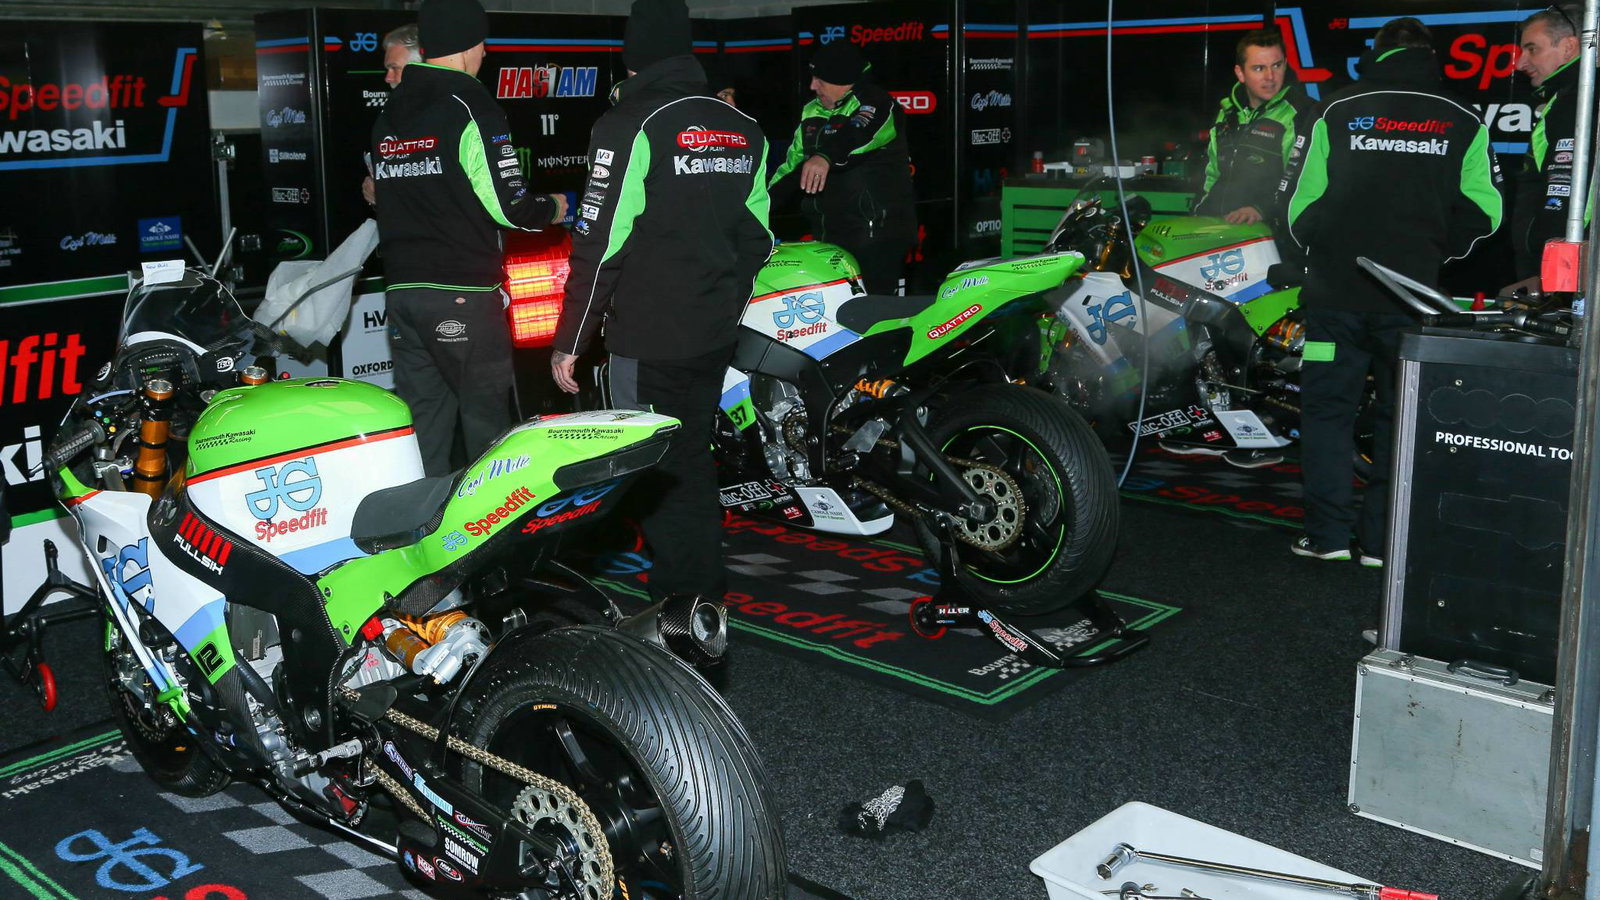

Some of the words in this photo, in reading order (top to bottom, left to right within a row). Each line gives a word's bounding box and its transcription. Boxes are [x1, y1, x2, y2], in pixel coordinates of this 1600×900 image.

[850, 20, 924, 48] Speedfit
[363, 90, 387, 98] Bourn
[1375, 117, 1448, 135] Speedfit
[379, 139, 435, 153] QUATTRO
[681, 133, 748, 146] QUATTRO
[1350, 135, 1450, 156] Kawasaki
[673, 155, 753, 176] Kawasaki
[928, 305, 980, 338] QUATTRO
[352, 360, 394, 375] OXFORD
[729, 405, 748, 427] 37
[225, 429, 256, 439] Kawasaki
[590, 427, 624, 435] Kawasaki
[1435, 431, 1547, 458] PROFESSIONAL
[464, 486, 536, 537] Speedfit
[522, 500, 602, 534] Speedfit
[254, 507, 329, 542] Speedfit
[173, 533, 224, 576] FULLSIX
[989, 619, 1028, 652] Speedfit
[444, 836, 479, 870] SOMROW
